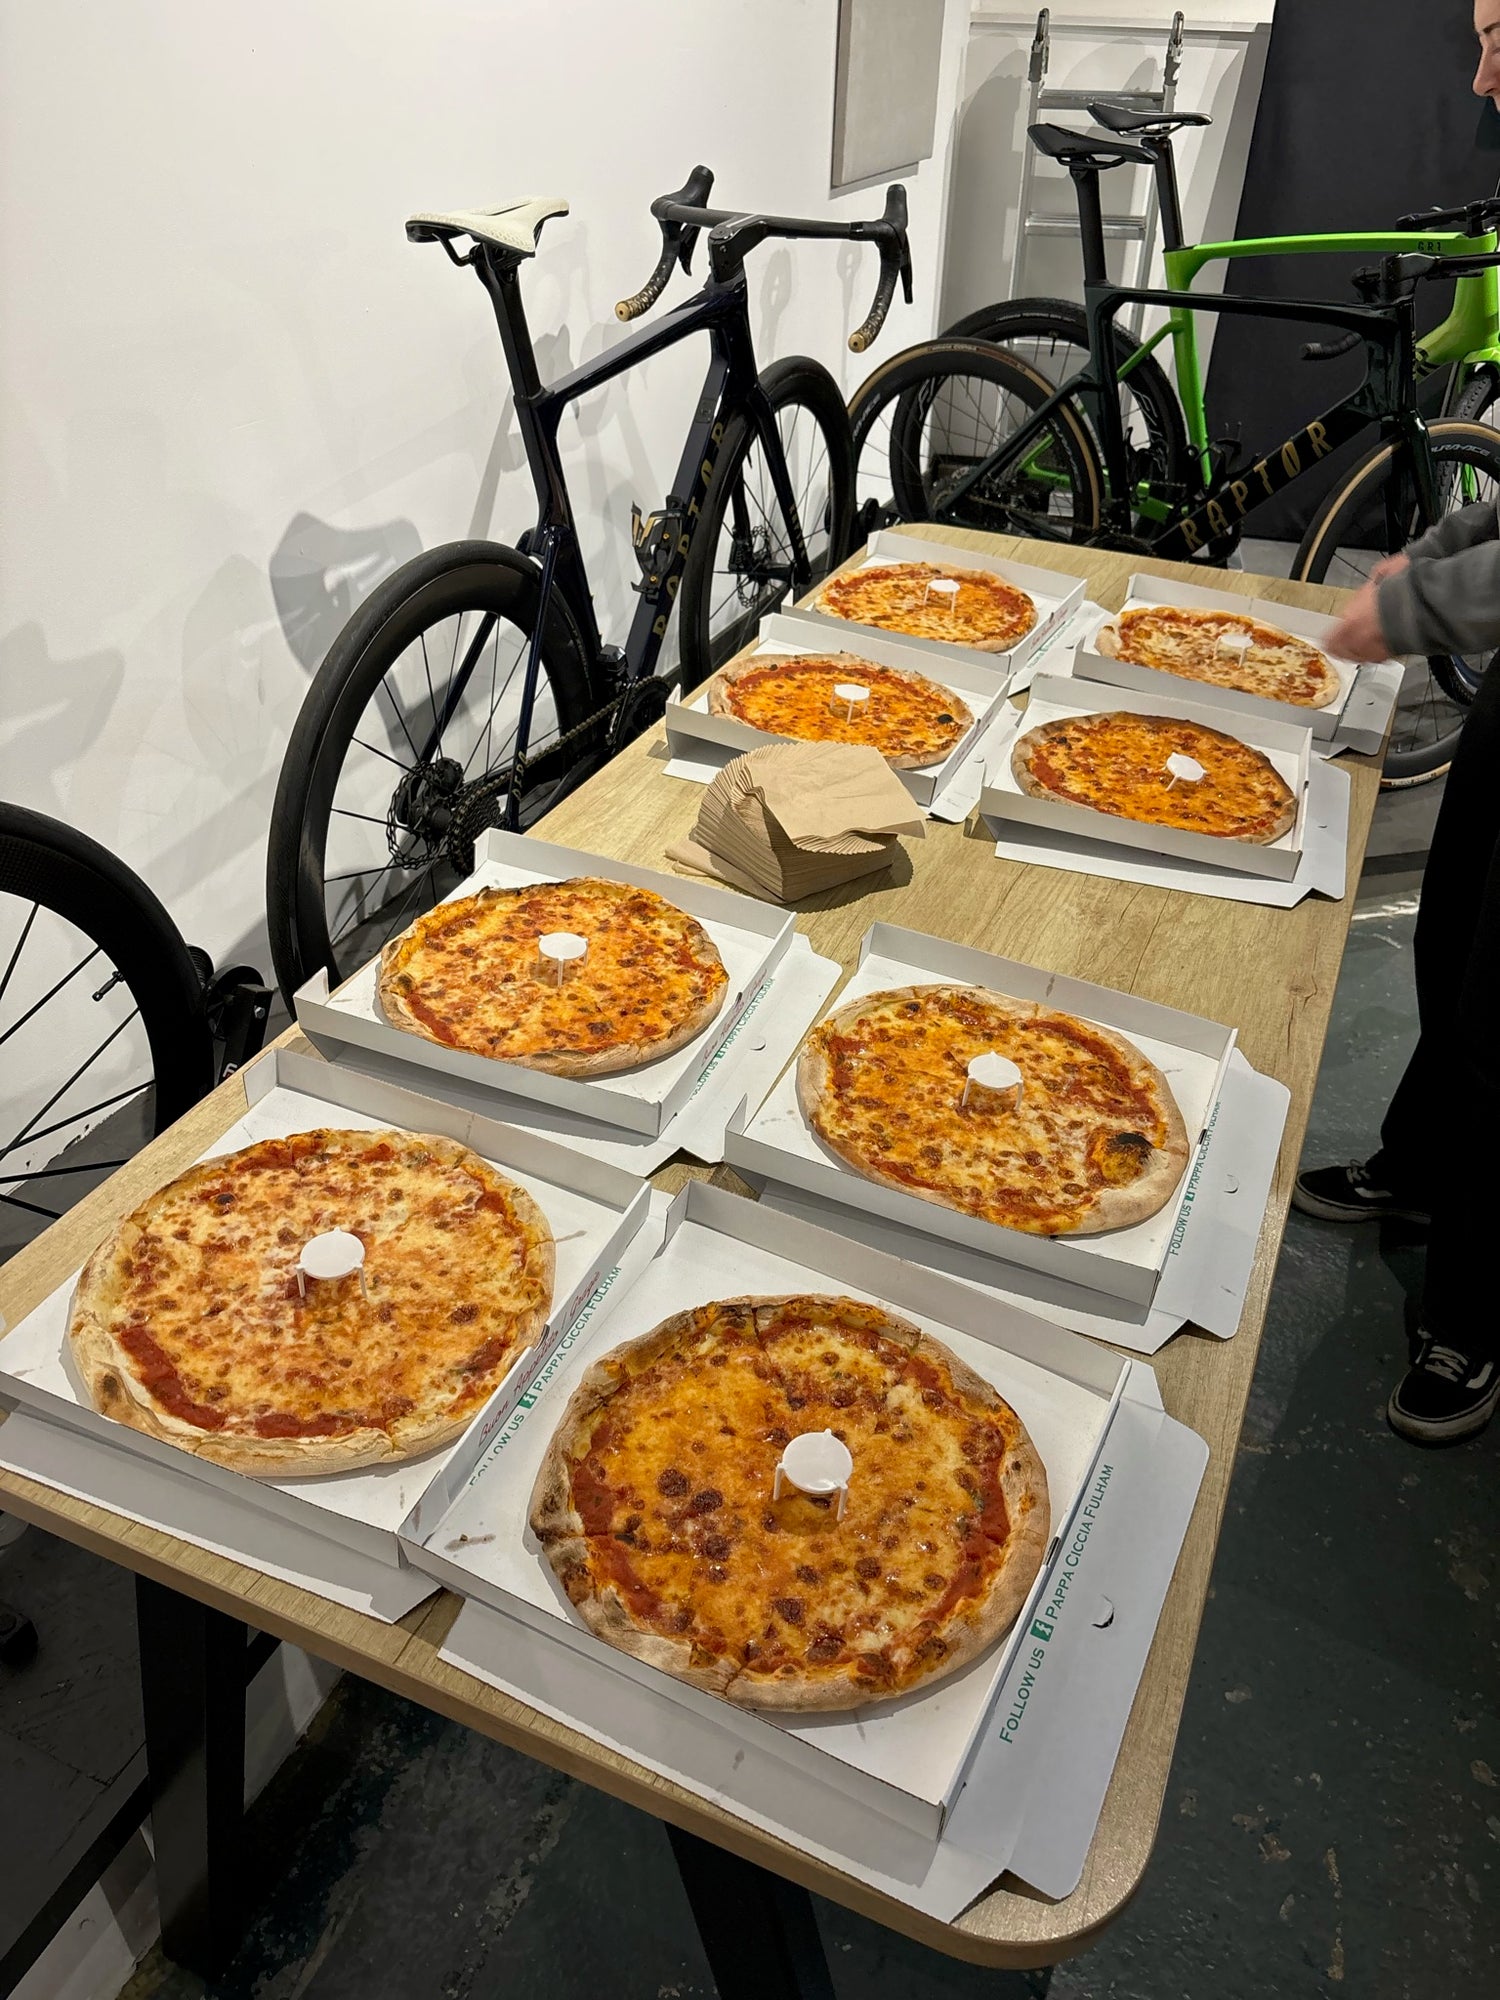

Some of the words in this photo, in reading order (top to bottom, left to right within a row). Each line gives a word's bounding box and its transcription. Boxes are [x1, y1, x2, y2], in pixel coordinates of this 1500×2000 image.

[1417, 241, 1441, 251] GR1
[1178, 421, 1333, 551] RAPTOR
[689, 1069, 712, 1101] OLLOW
[708, 1060, 719, 1071] US
[723, 1026, 743, 1050] PAPPA
[738, 1003, 758, 1027] CICCIA
[1169, 1219, 1188, 1256] FOLLOW
[1181, 1204, 1192, 1217] US
[1188, 1157, 1206, 1190] PAPPA
[509, 1413, 525, 1431] US
[533, 1352, 566, 1393] PAPPA
[562, 1311, 593, 1350] CICCIA
[586, 1266, 622, 1310] FULHAM
[999, 1671, 1037, 1744] FOLLOW
[1028, 1647, 1045, 1671] US
[1045, 1570, 1075, 1620] PAPPA
[1065, 1520, 1093, 1567] CICCIA
[1083, 1463, 1114, 1519] FULHAM
